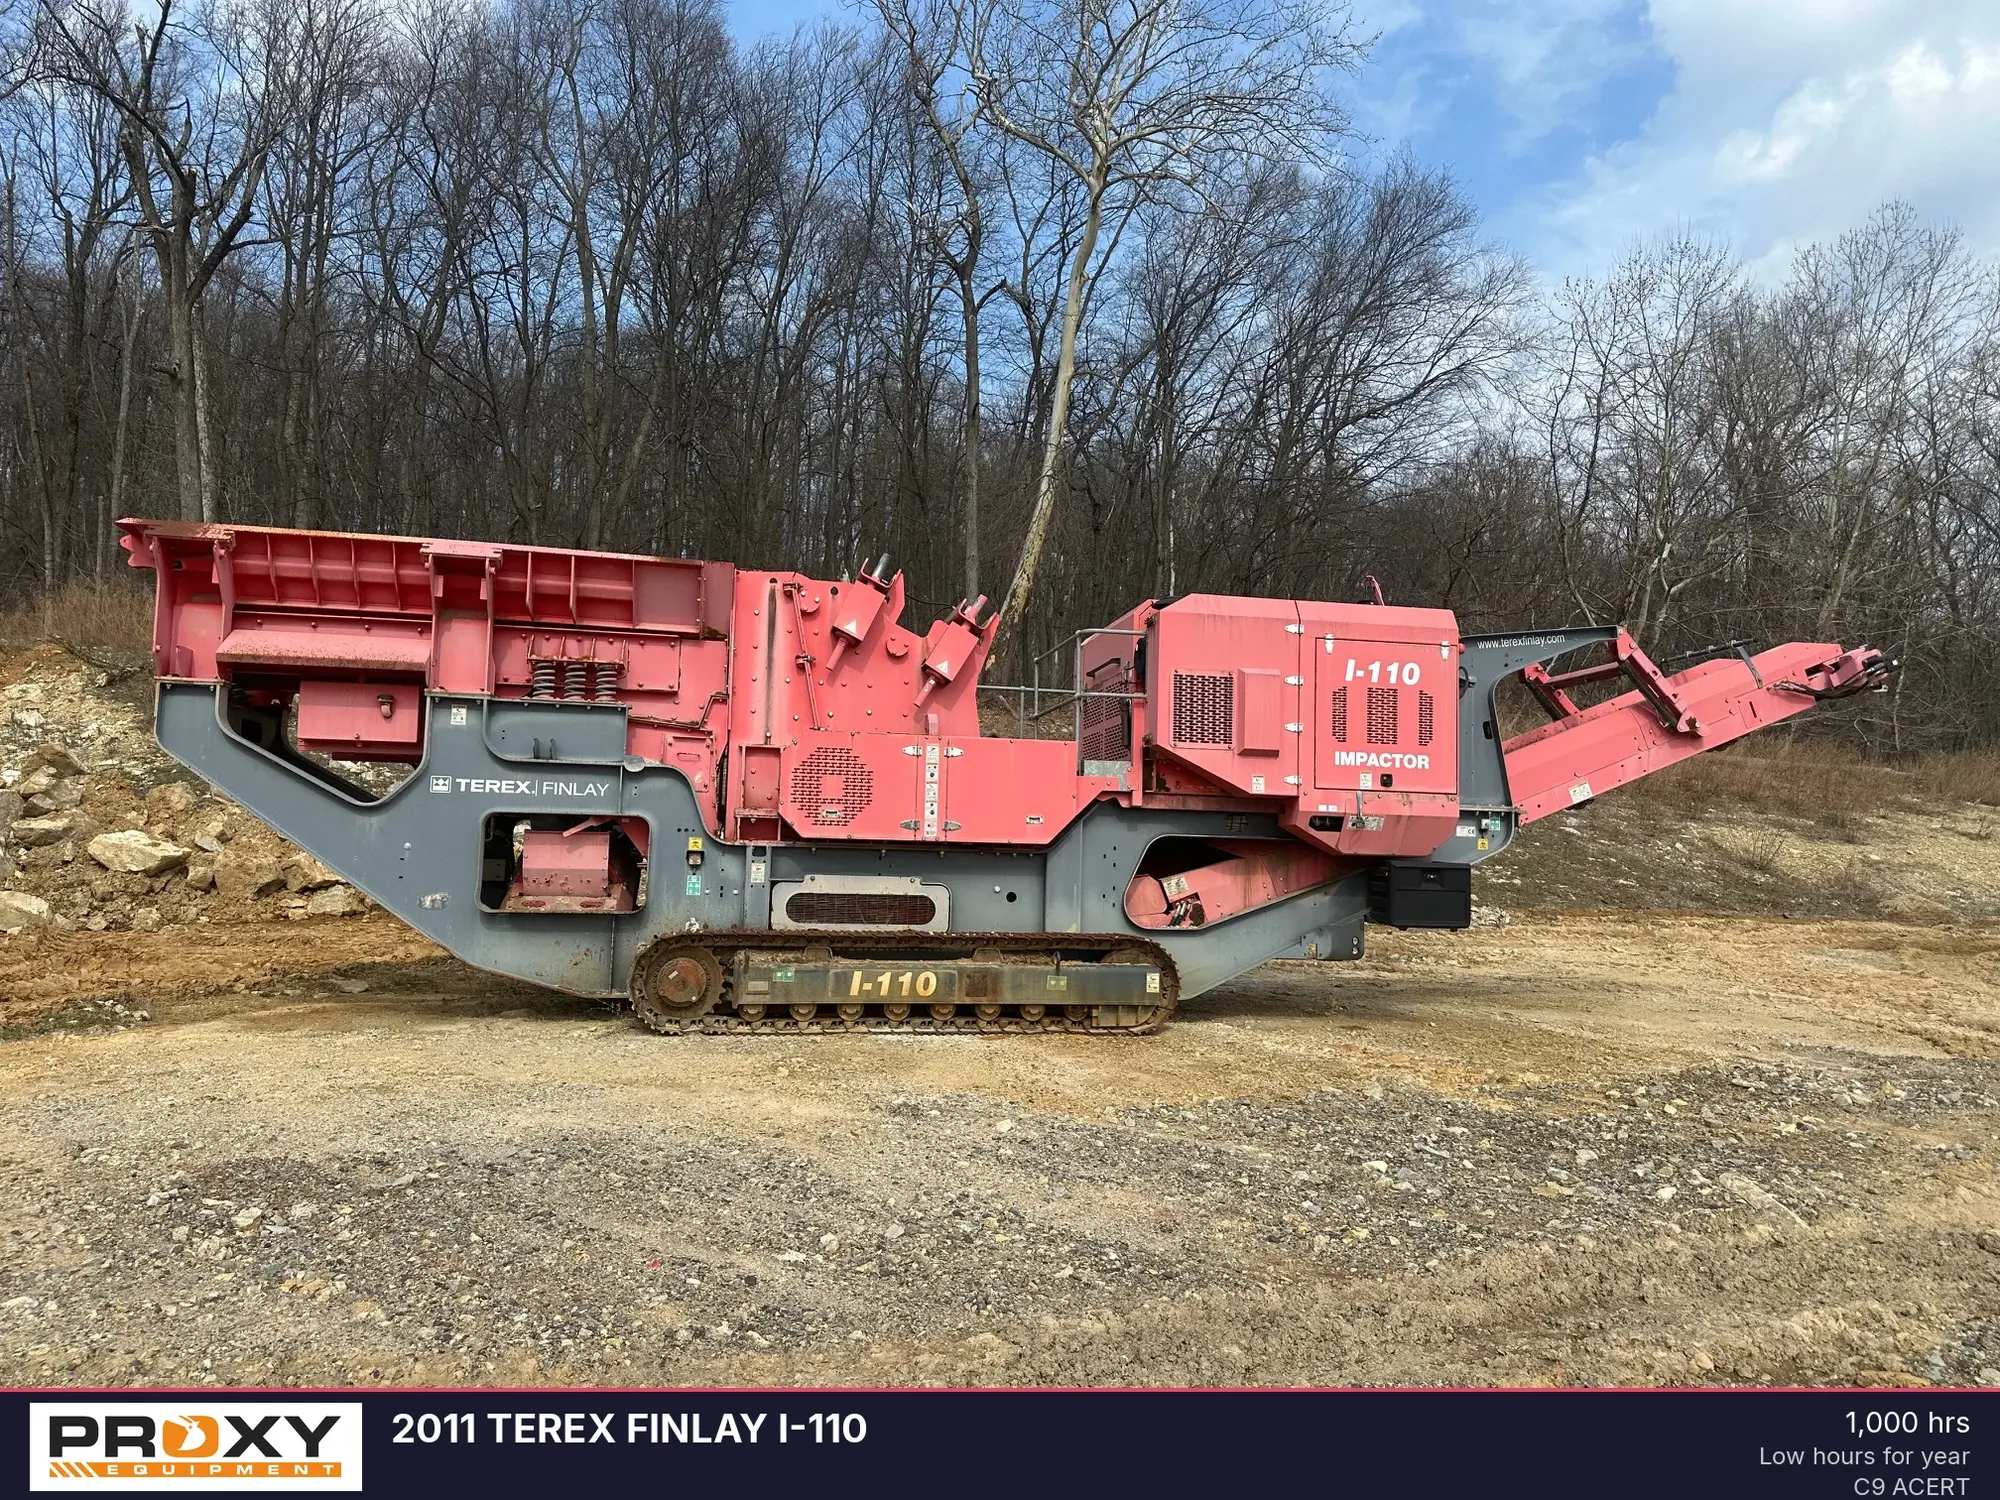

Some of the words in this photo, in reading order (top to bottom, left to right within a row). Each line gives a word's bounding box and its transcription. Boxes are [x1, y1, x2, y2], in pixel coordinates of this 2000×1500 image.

[1477, 634, 1566, 650] www.terexfinlay.com
[1344, 658, 1421, 686] I-110
[1334, 751, 1430, 770] IMPACTOR
[542, 781, 610, 797] FINLAY
[849, 970, 937, 997] I-110
